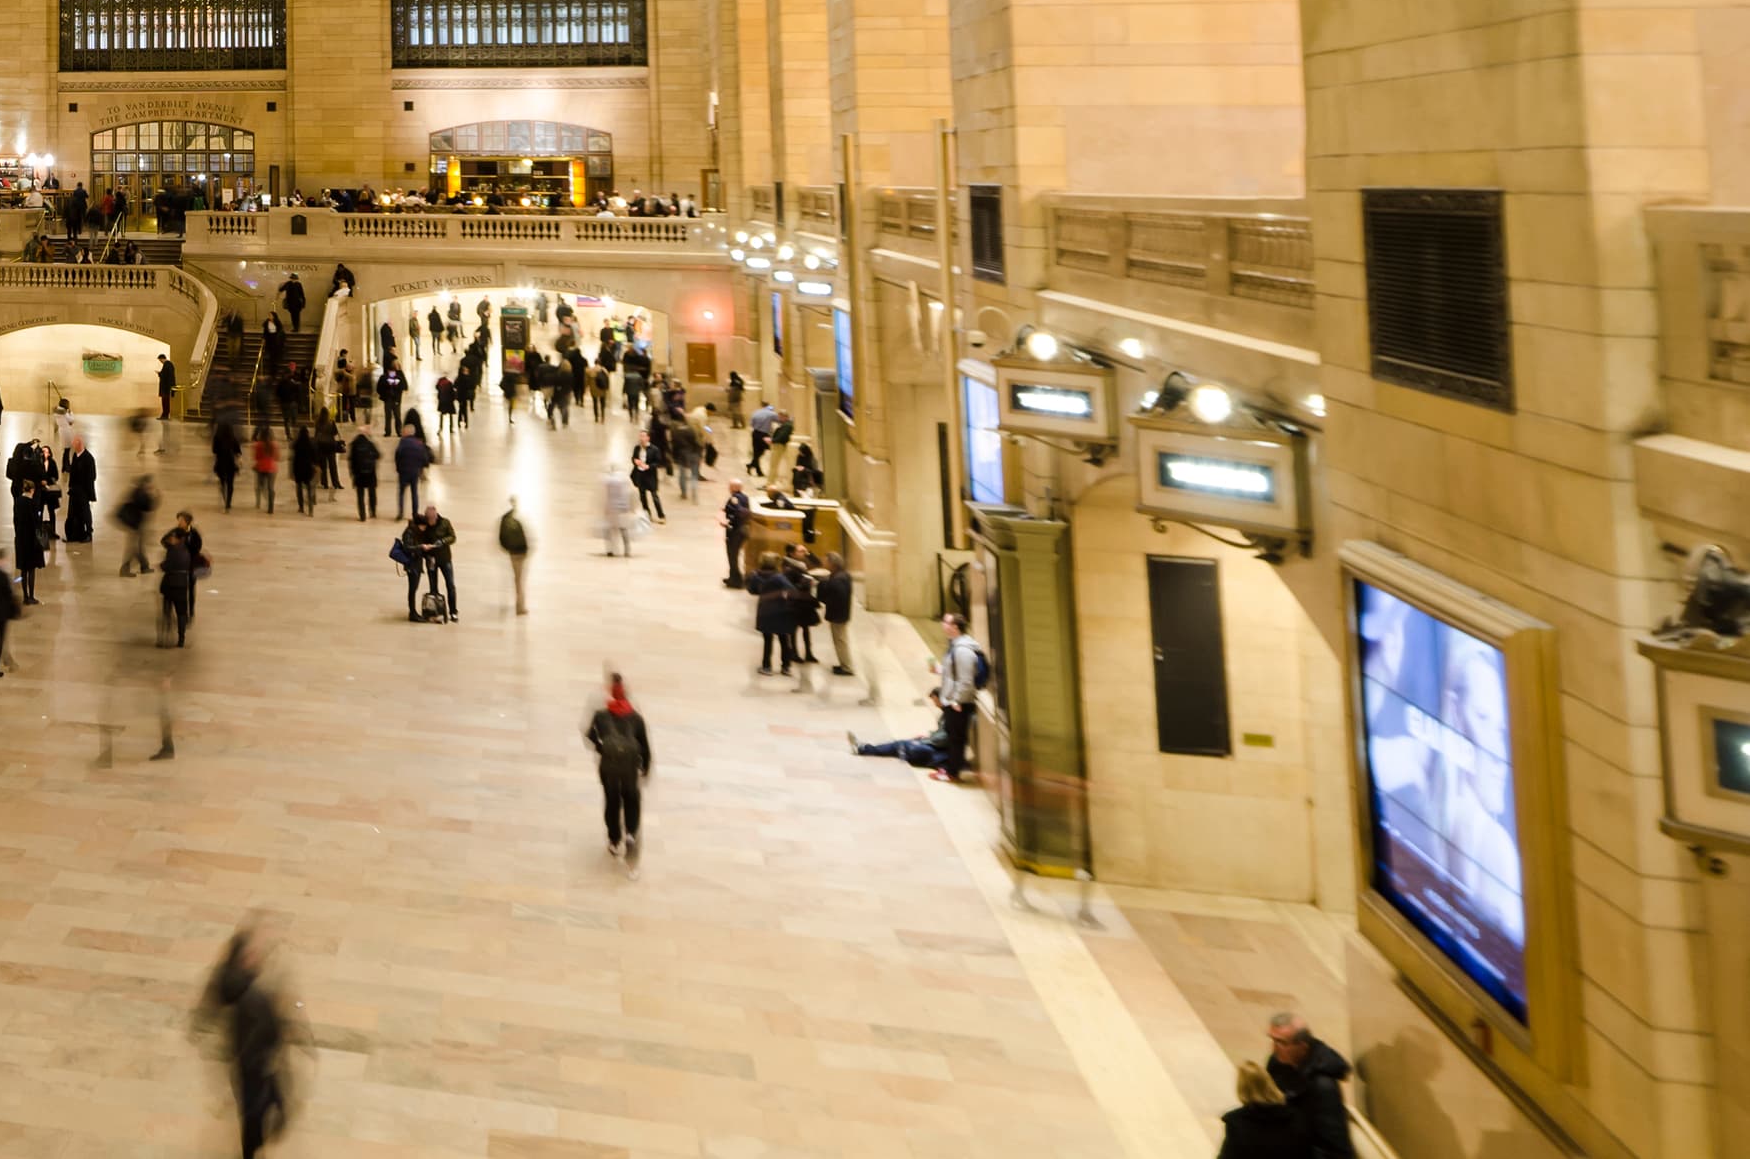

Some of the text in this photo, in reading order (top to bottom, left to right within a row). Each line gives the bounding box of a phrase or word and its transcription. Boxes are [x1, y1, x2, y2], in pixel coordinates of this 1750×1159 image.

[107, 100, 237, 115] TO VANDERBILT AVENUE
[99, 109, 245, 126] THE CAMPBELL APARTMENT
[282, 264, 319, 272] BALCONY
[392, 274, 492, 294] TICKET MACHINES
[533, 277, 578, 290] TRACKS
